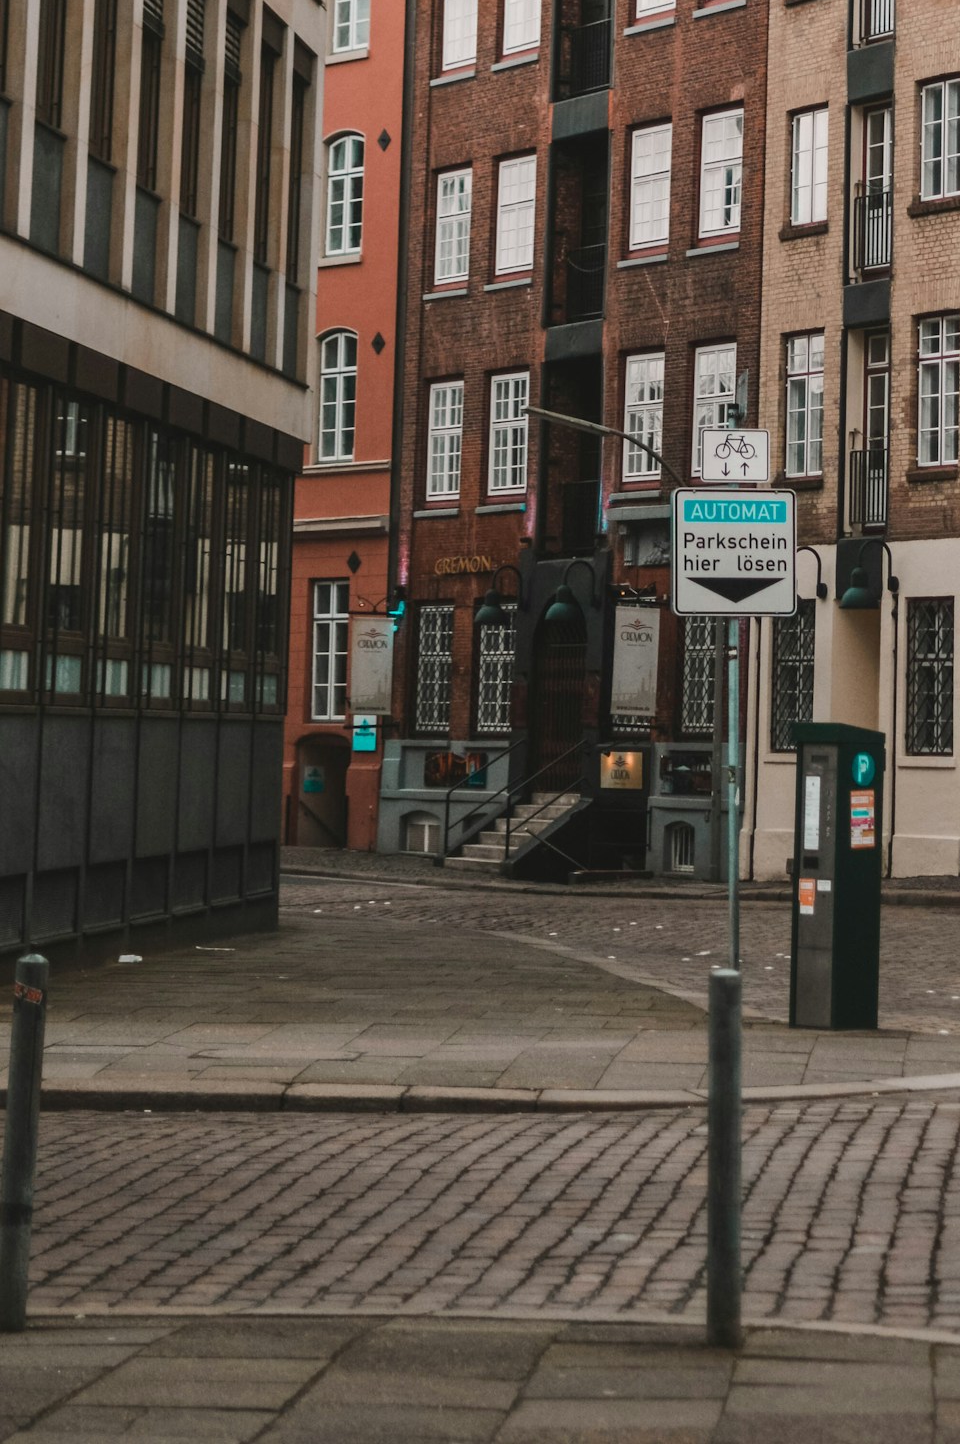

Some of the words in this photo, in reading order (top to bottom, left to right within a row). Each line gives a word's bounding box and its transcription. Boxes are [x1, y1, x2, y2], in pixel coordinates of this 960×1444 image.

[690, 503, 781, 520] AUTOMAT
[684, 533, 787, 550] Parkschein
[434, 555, 492, 575] CREMON
[684, 555, 720, 571] hier
[737, 555, 787, 572] lösen
[857, 754, 869, 784] P
